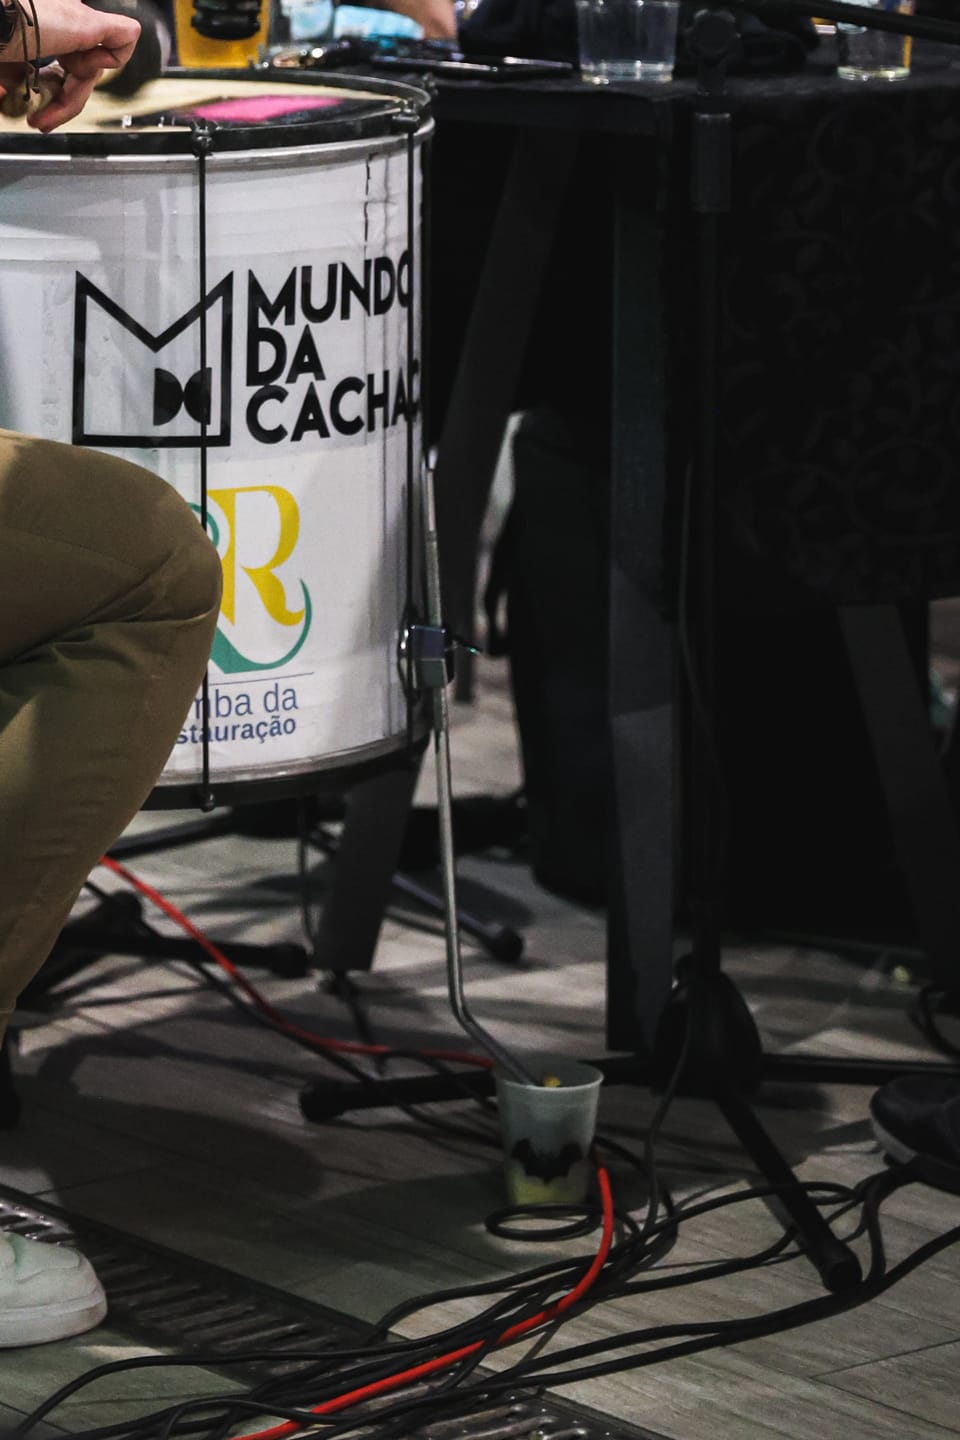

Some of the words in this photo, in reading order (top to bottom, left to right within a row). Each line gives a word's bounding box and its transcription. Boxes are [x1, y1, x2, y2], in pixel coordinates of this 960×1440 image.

[249, 250, 413, 326] MUNDO
[246, 324, 326, 386] DA
[194, 689, 253, 719] mba
[263, 682, 299, 713] da
[177, 715, 296, 744] stauração
